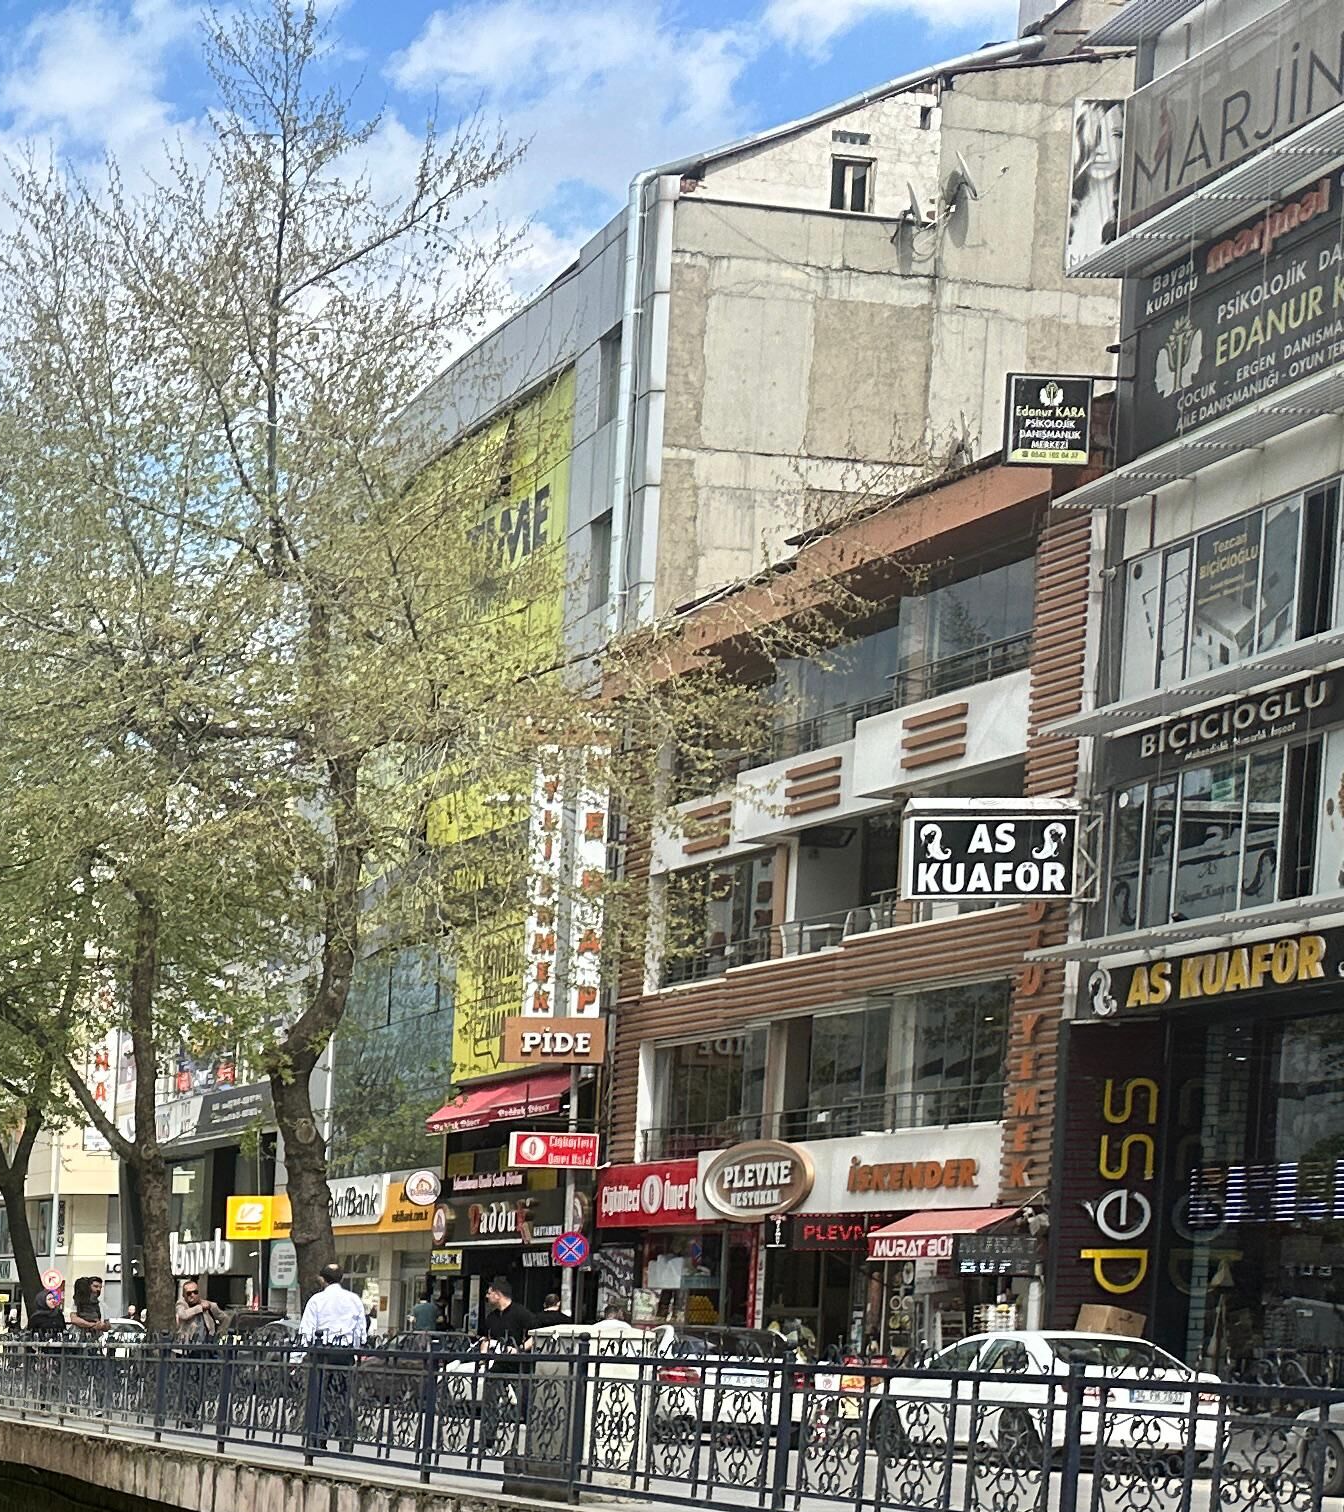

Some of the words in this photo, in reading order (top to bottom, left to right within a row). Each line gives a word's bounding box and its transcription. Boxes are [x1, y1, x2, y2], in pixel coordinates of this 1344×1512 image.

[1152, 259, 1195, 293] Bayan
[1216, 260, 1308, 325] PSİKOLOJİK
[1215, 285, 1324, 368] EDANUR
[1176, 380, 1217, 413] ÇOCUK
[1236, 351, 1277, 383] ERGEN
[1198, 368, 1280, 421] DANIŞMANLIĞI
[1288, 349, 1325, 378] OYUN
[1015, 405, 1053, 417] Edanur
[1055, 406, 1086, 418] KARA
[1025, 417, 1076, 429] PSİKOLOJİK
[1030, 439, 1069, 449] MERKEZİ
[967, 822, 1016, 854] AS
[916, 861, 1066, 893] KUAFÖR
[1125, 960, 1172, 1009] AS
[1179, 935, 1327, 1000] KUAFÖR
[520, 1026, 591, 1056] PİDE
[1007, 1013, 1043, 1187] YEMEK
[722, 1159, 792, 1189] PLEVNE
[847, 1156, 979, 1193] İSKENDER
[663, 1173, 689, 1211] Ömer
[873, 1237, 922, 1257] MURAT
